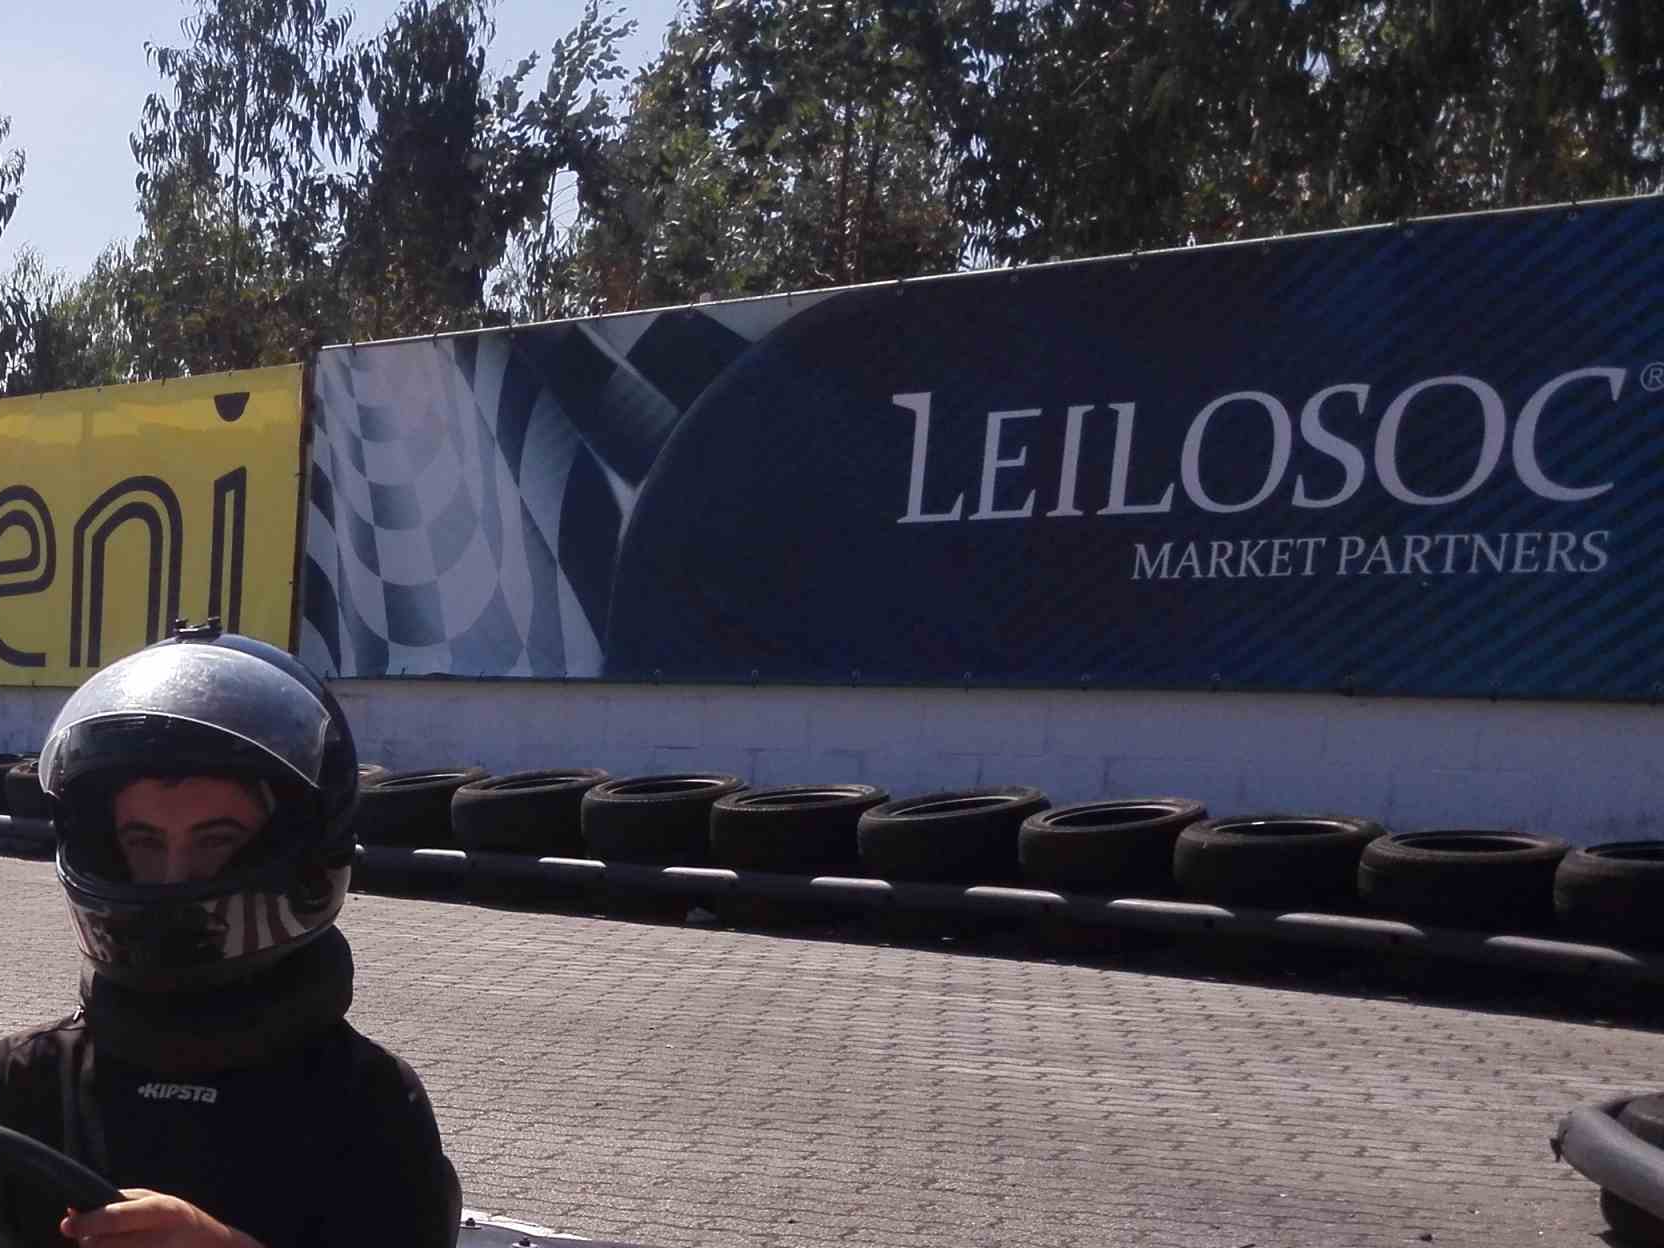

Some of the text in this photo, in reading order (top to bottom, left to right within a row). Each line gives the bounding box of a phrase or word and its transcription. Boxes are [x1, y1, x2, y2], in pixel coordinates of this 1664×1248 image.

[892, 366, 1625, 525] LEILOSOC
[1131, 529, 1611, 581] MARKET PARTNERS
